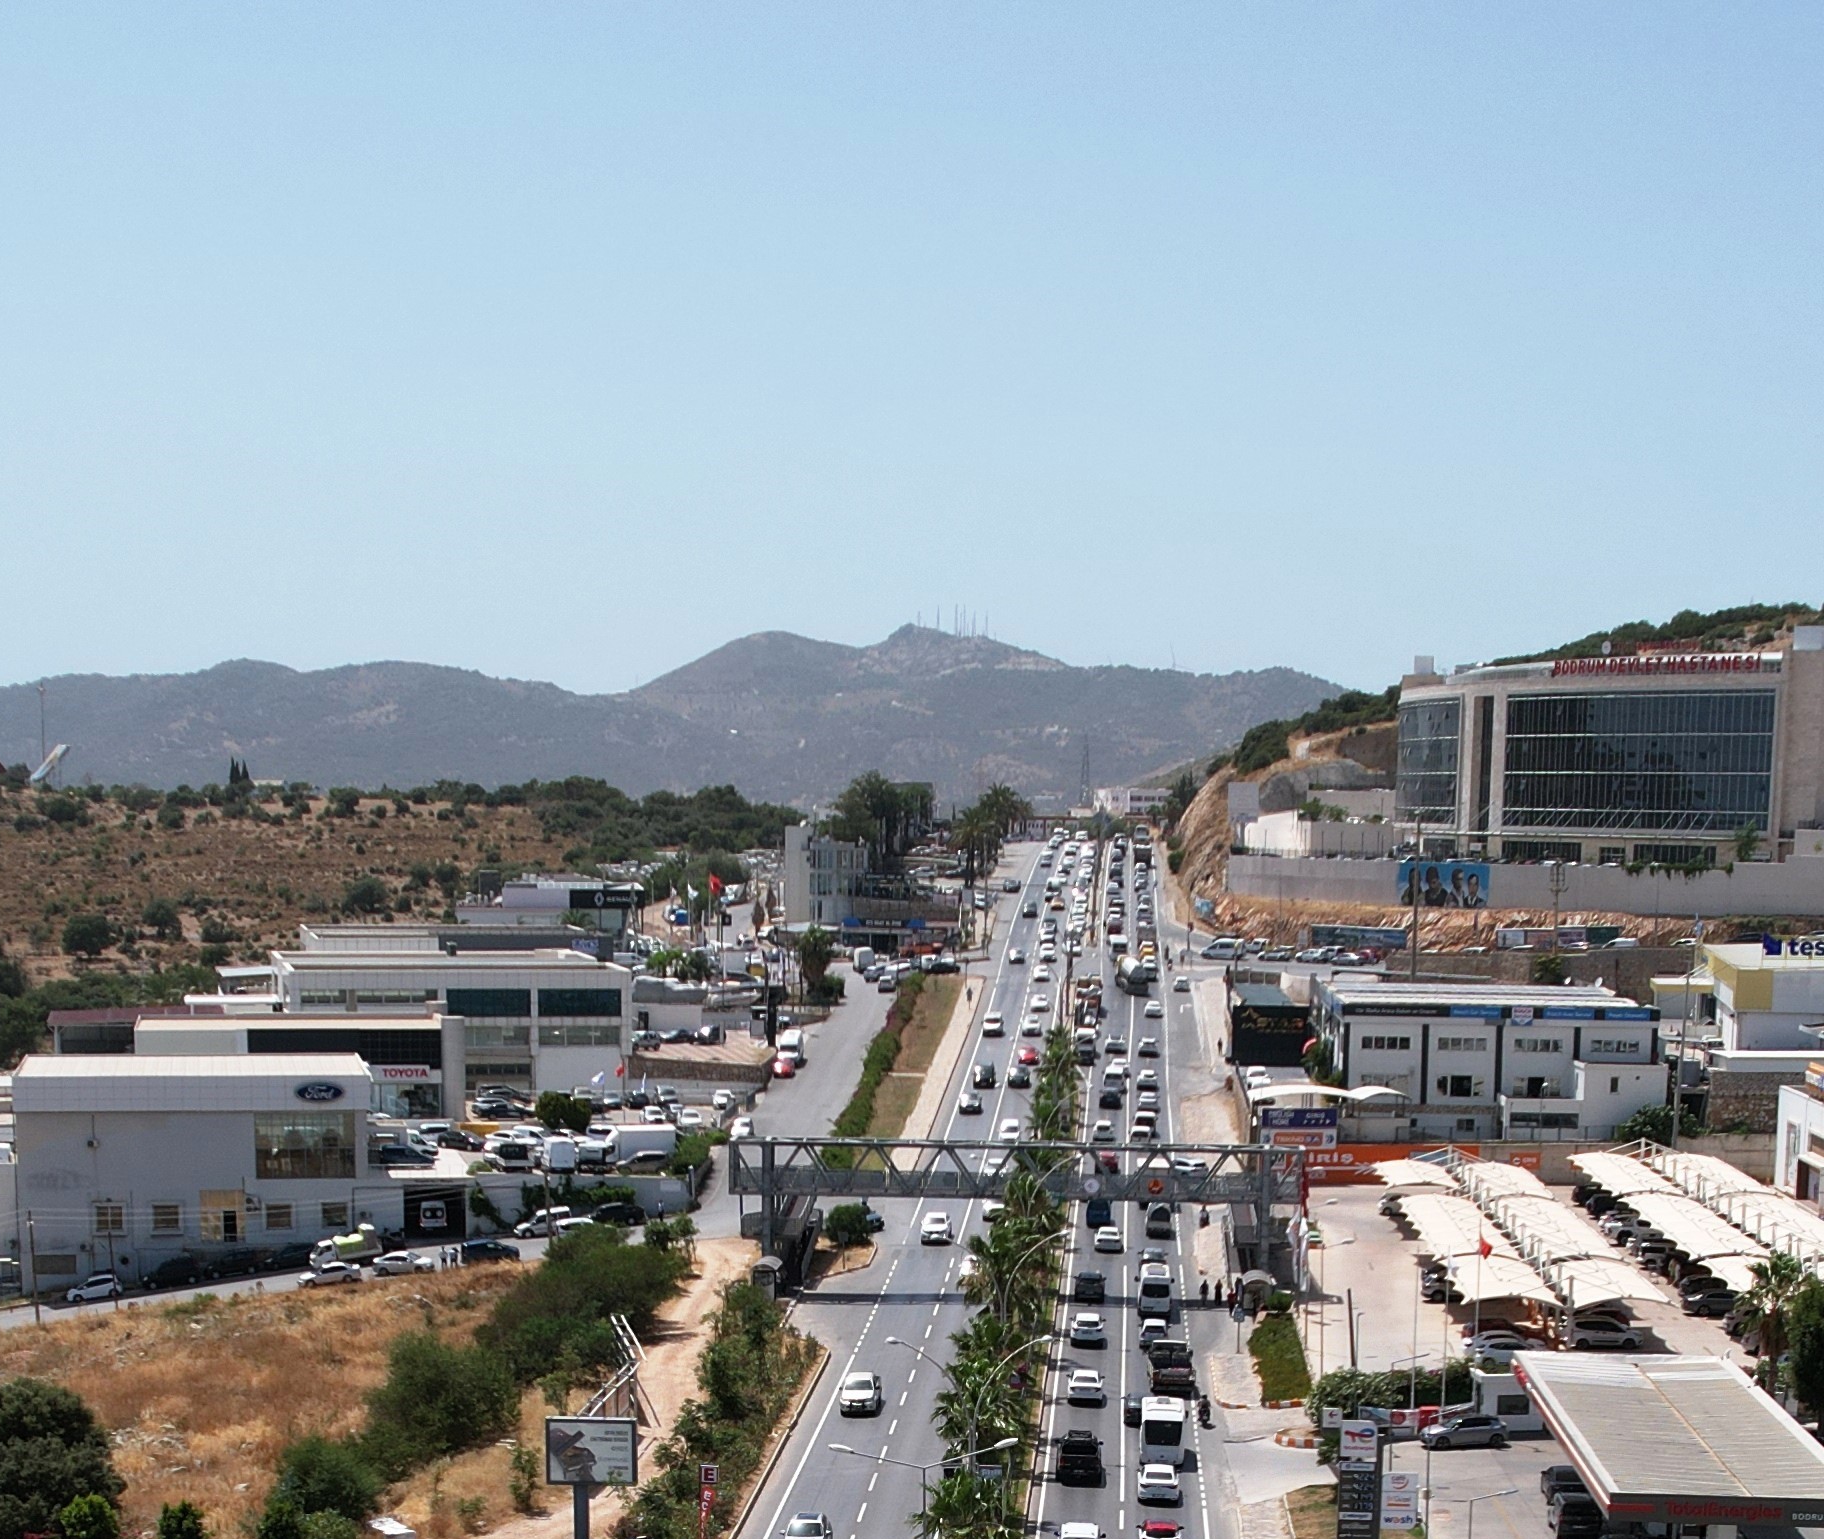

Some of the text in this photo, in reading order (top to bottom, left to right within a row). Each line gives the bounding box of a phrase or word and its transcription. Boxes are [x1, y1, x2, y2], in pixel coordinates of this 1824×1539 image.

[1552, 658, 1606, 677] BODRUM
[1609, 656, 1664, 674] DEVLET
[382, 1067, 429, 1079] TOYOTA
[305, 1085, 334, 1101] Ford
[1665, 1501, 1782, 1521] TotalEnergies
[1384, 1515, 1413, 1524] wash
